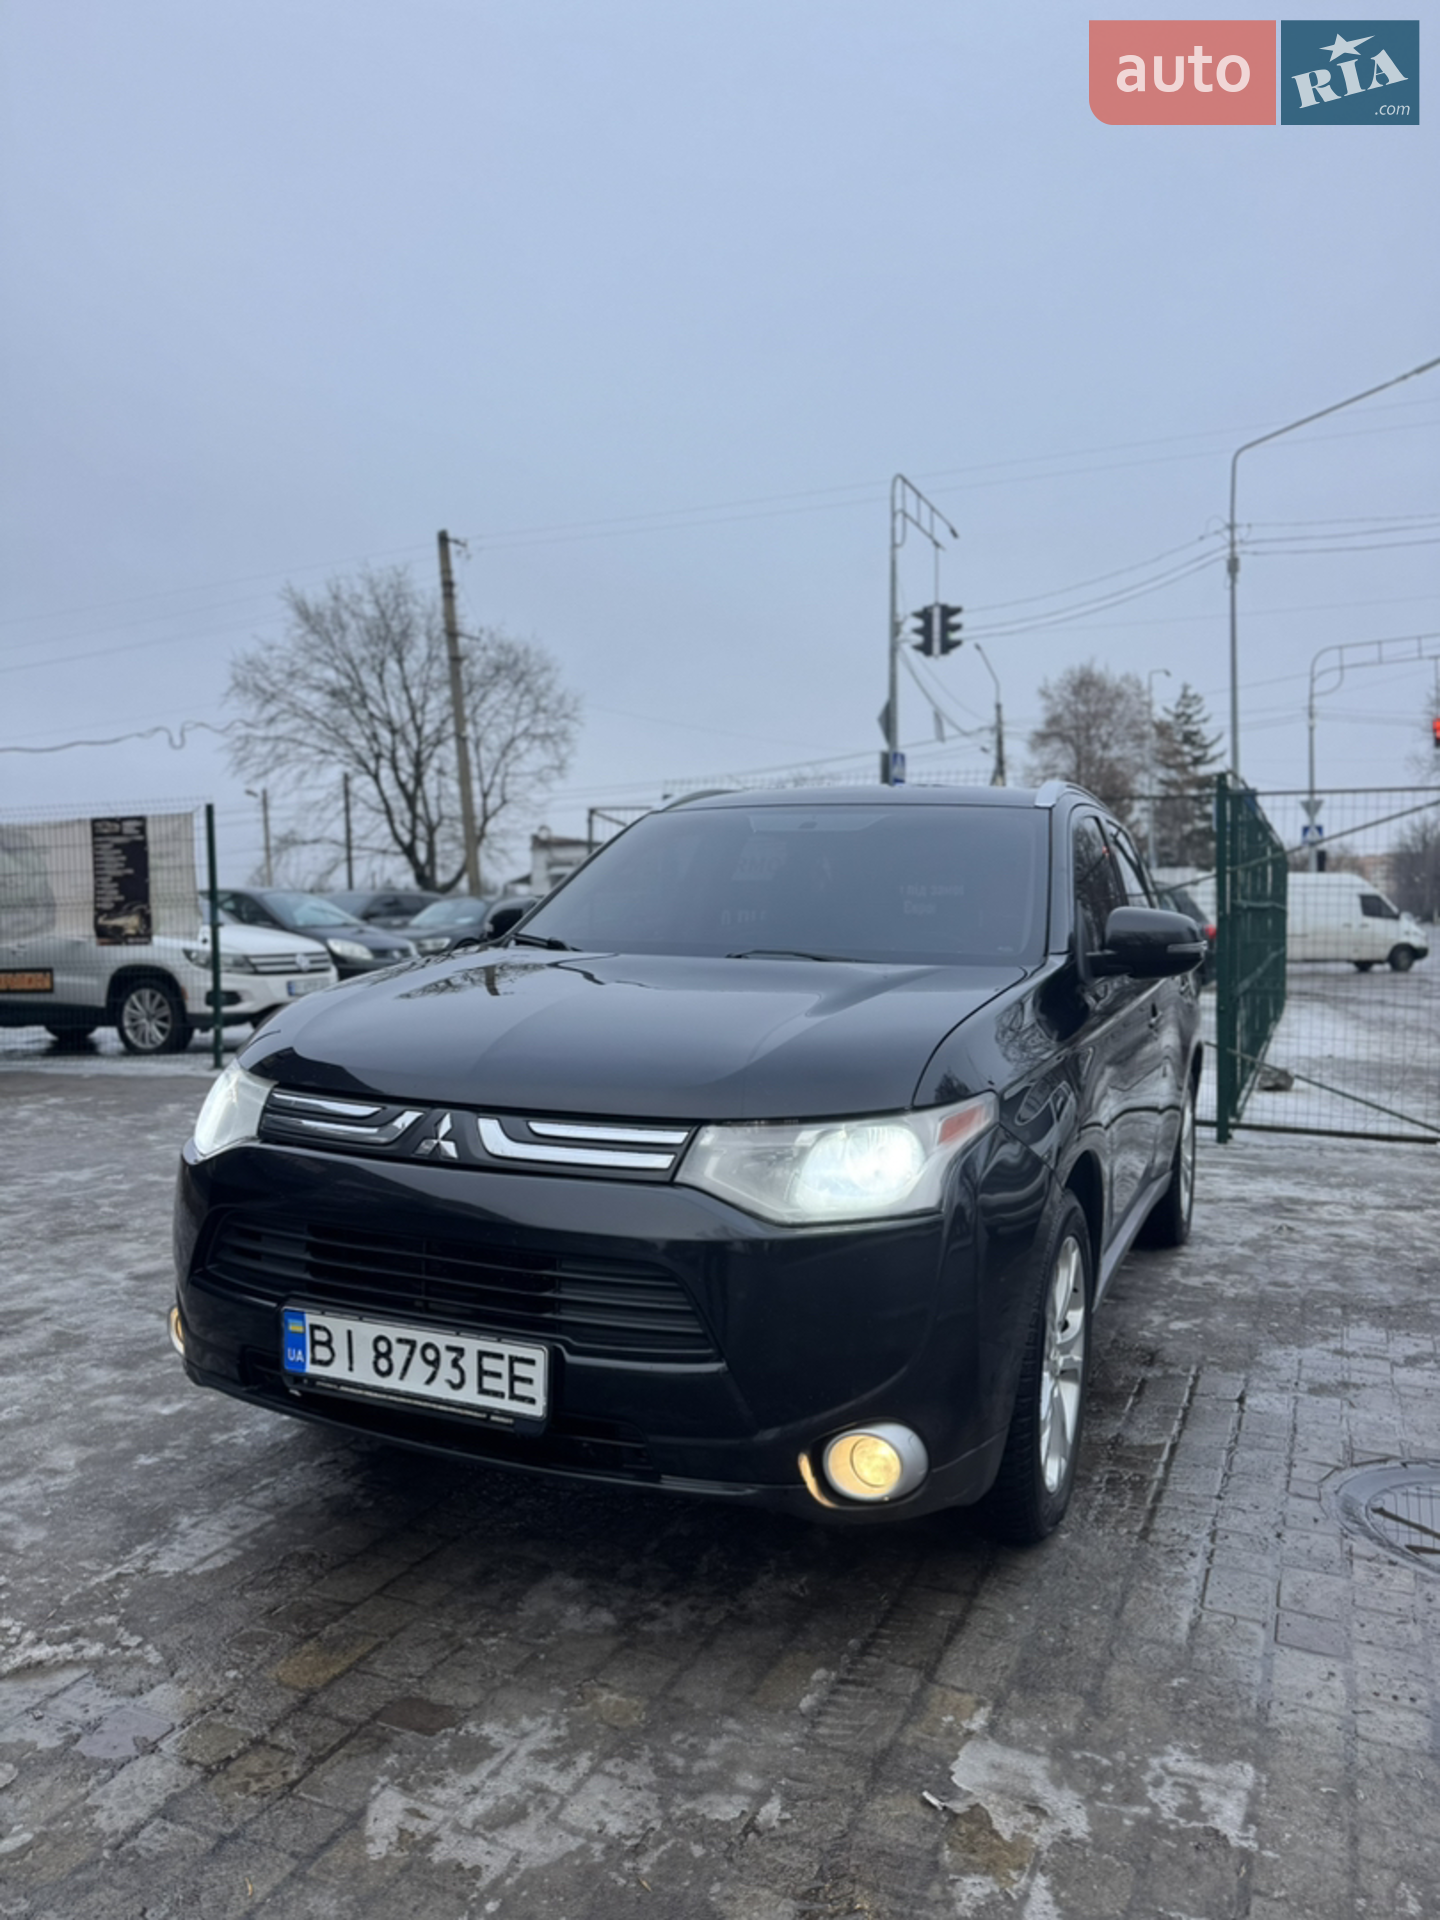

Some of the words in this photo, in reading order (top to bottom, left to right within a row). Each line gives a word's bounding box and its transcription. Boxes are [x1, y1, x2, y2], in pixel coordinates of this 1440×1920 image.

[287, 1348, 305, 1362] UA
[308, 1323, 354, 1373] BI
[372, 1335, 466, 1391] 8793
[477, 1349, 537, 1406] EE
